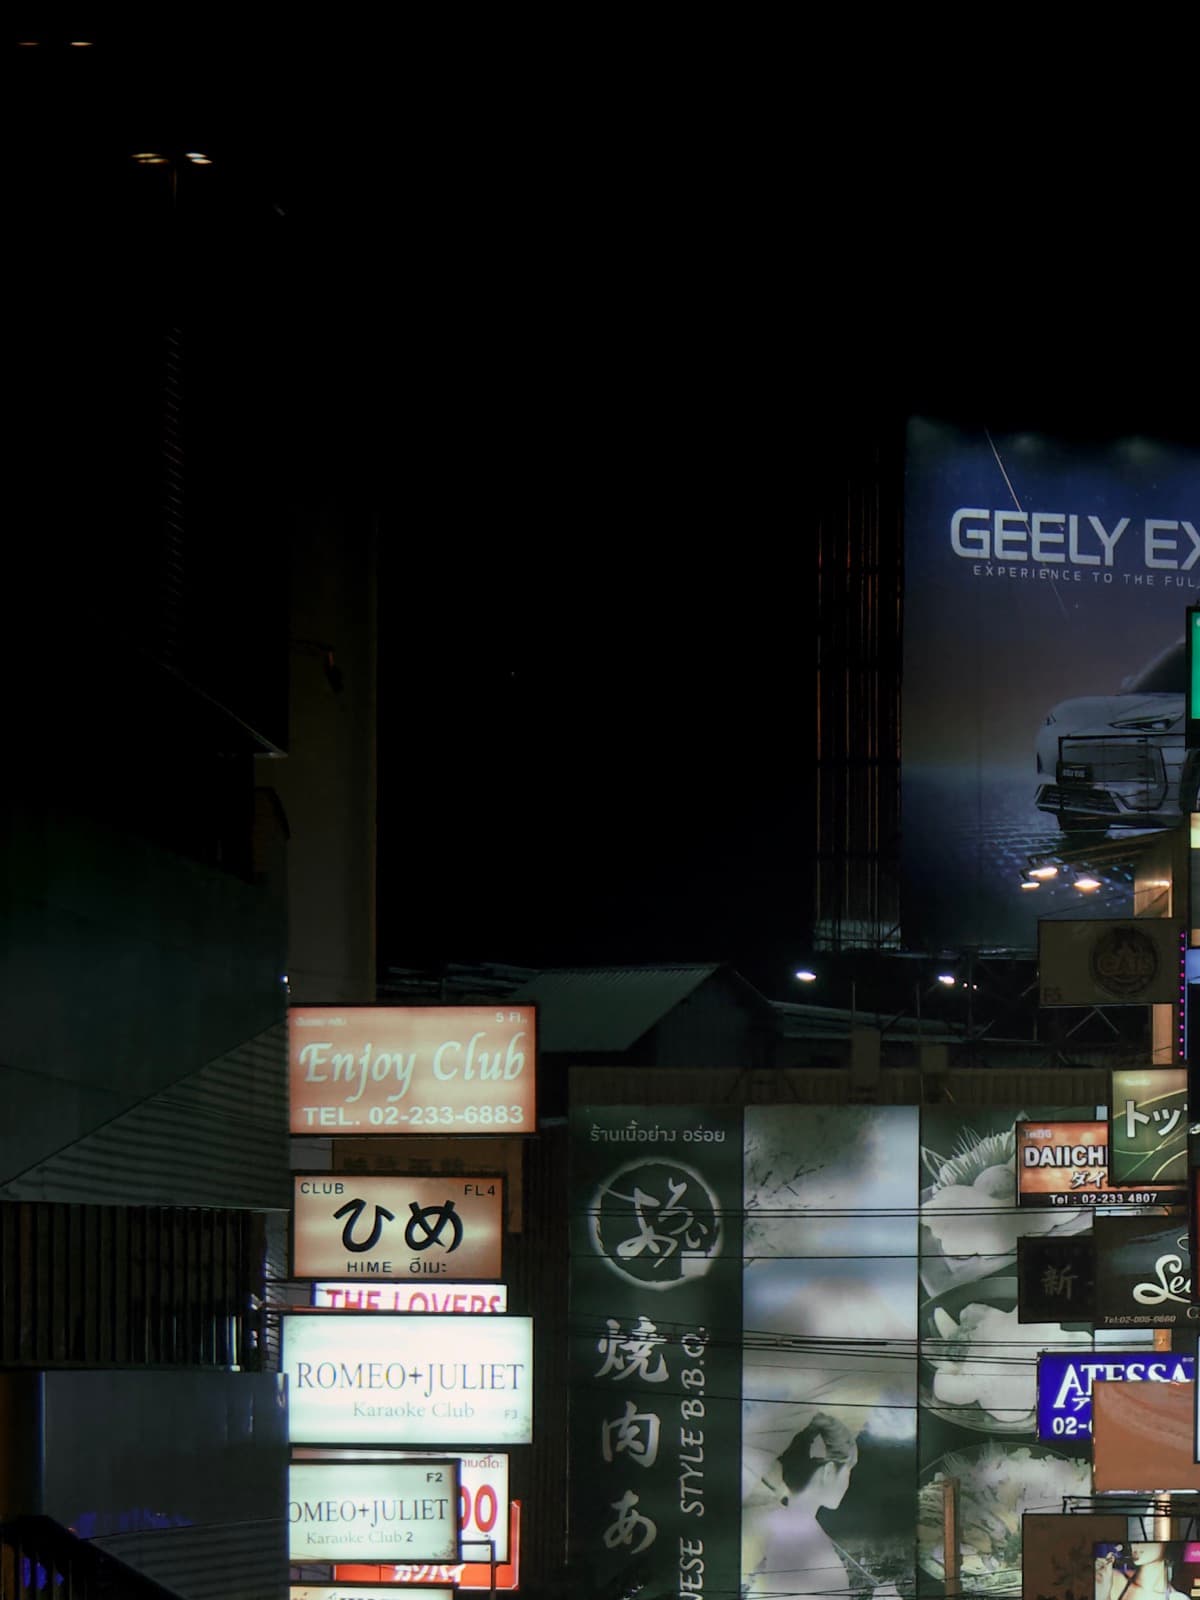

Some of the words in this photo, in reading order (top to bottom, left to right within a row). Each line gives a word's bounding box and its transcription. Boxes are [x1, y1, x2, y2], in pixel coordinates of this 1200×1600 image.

[951, 508, 1130, 566] GEELY
[973, 565, 1081, 581] EXPERIENCE
[1093, 572, 1113, 584] TO
[1124, 574, 1154, 586] THE
[299, 1042, 416, 1103] Enjoy
[433, 1032, 527, 1081] Club
[304, 1107, 360, 1125] TEL.
[369, 1105, 524, 1125] 02-233-6883
[1126, 1101, 1188, 1137] トッ
[300, 1182, 344, 1194] CLUB
[1071, 1170, 1107, 1189] ダイ
[333, 1198, 464, 1253] ひめ
[347, 1261, 393, 1273] HIME
[297, 1362, 524, 1397] ROMEO+JULIET
[353, 1402, 425, 1418] Karaoke
[432, 1402, 475, 1418] Club
[426, 1472, 443, 1483] F2
[678, 1428, 705, 1518] STYLE
[288, 1498, 448, 1527] OMEO+JULIET
[306, 1532, 364, 1545] Karaoke
[368, 1531, 402, 1544] Club
[405, 1531, 413, 1543] 2
